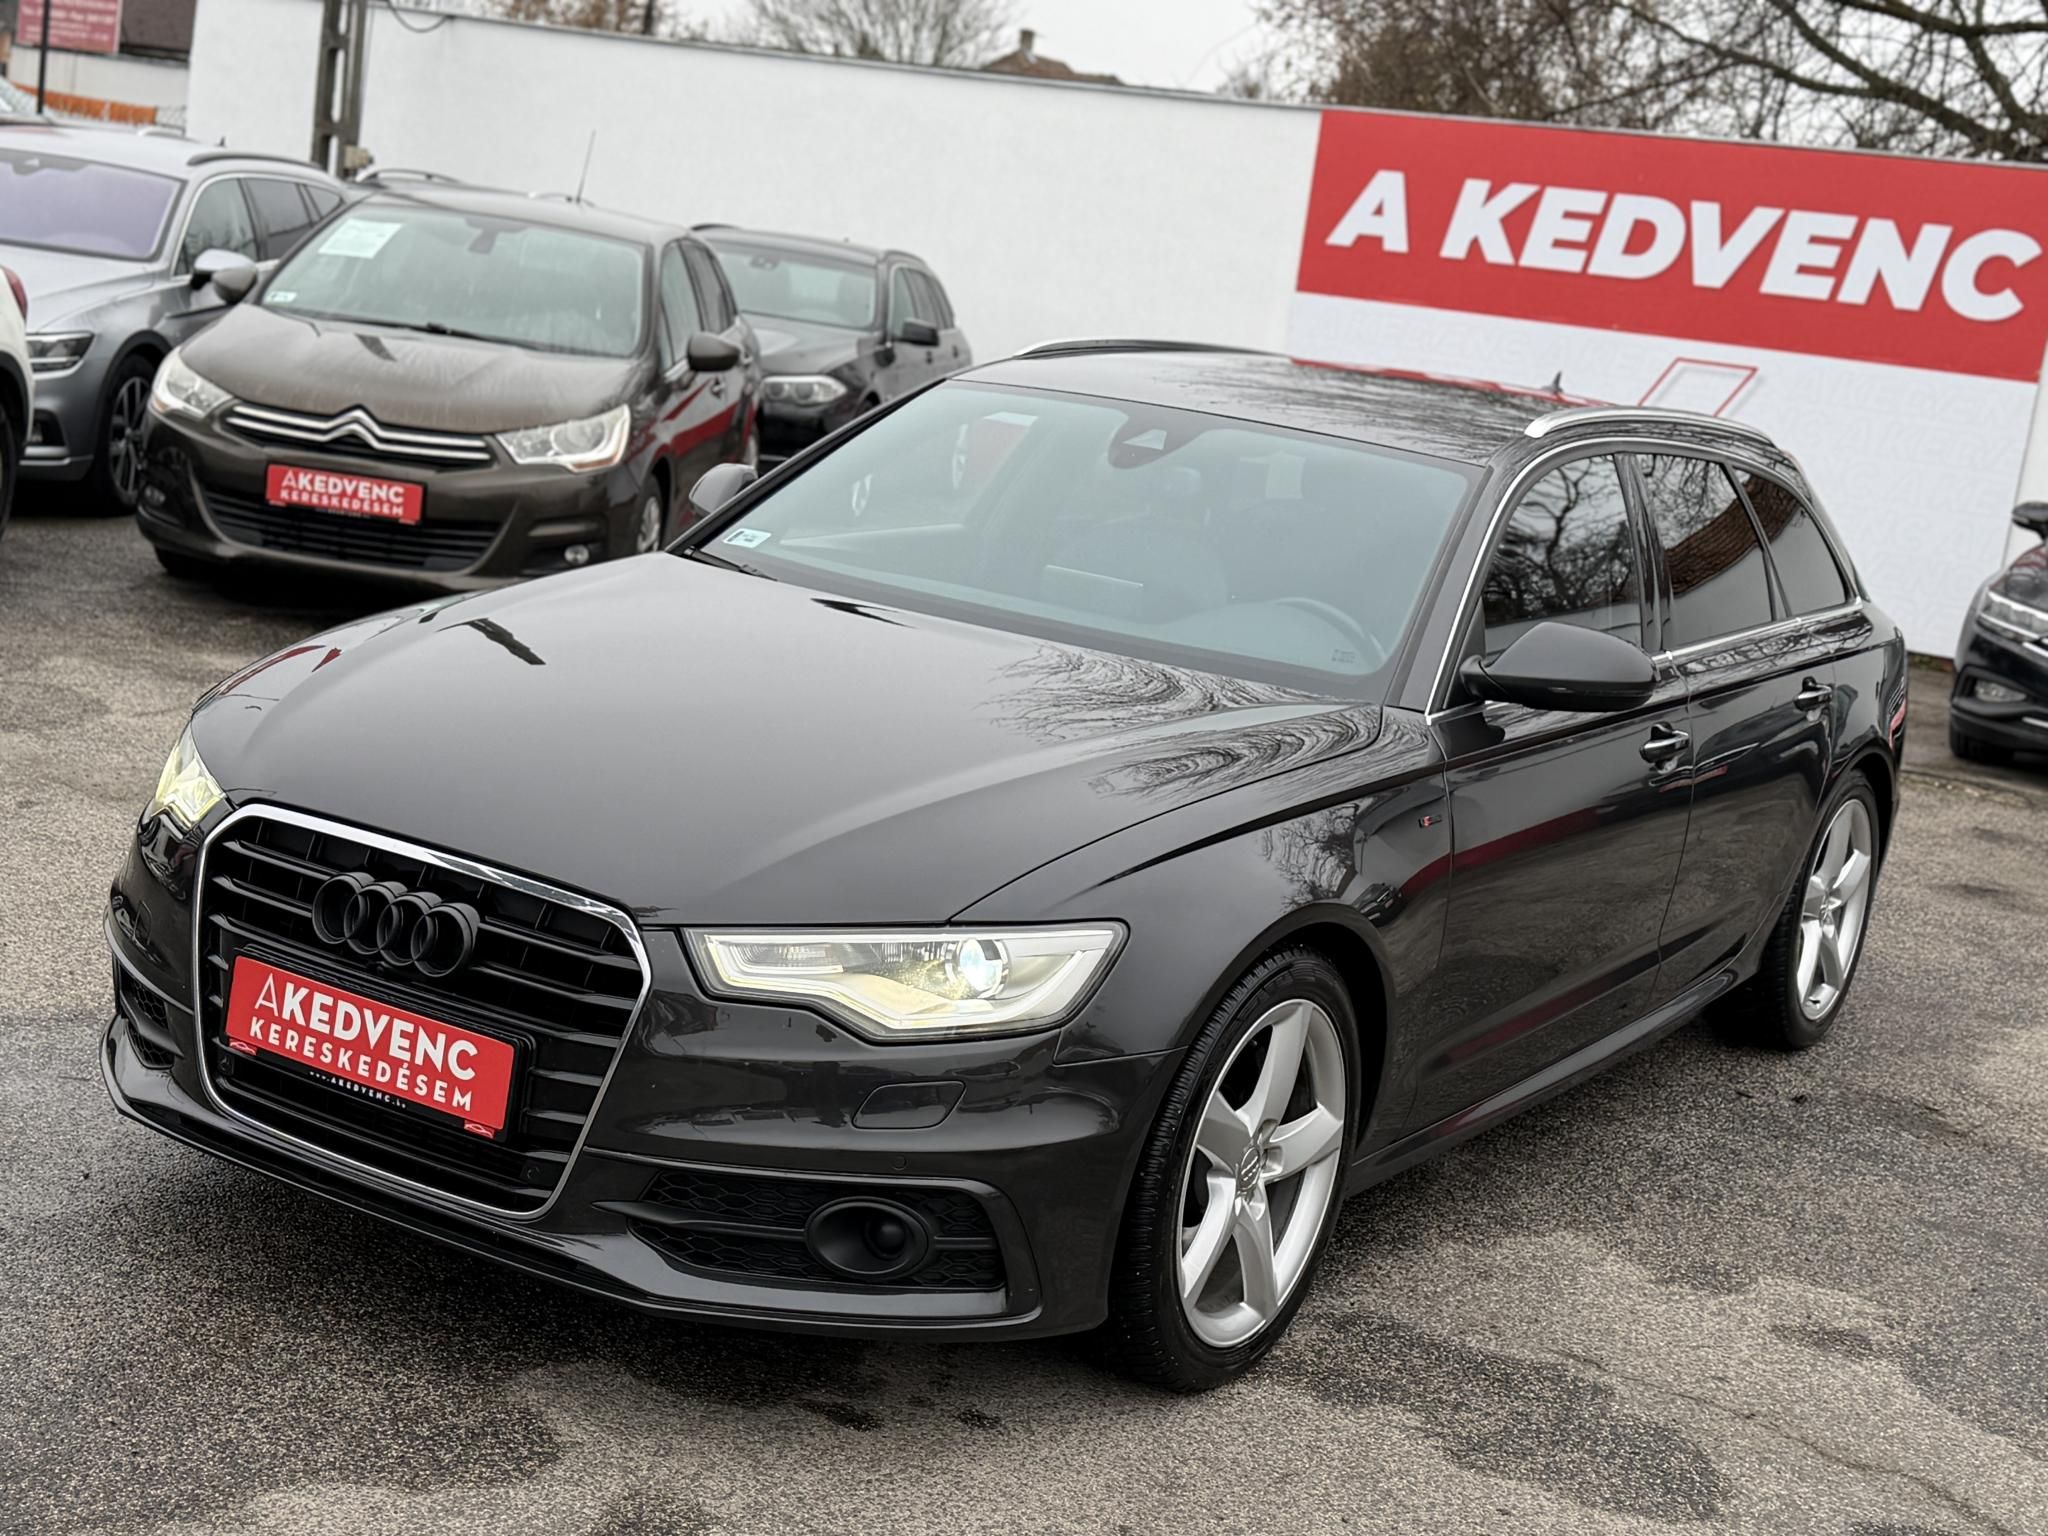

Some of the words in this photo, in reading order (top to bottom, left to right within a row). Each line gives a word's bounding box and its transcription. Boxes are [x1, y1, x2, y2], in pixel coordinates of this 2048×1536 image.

[1325, 169, 1409, 253] A
[1439, 177, 2043, 322] KEDVENC
[249, 1017, 473, 1112] KERESKEDÉSEM
[254, 973, 478, 1081] AKEDVENC
